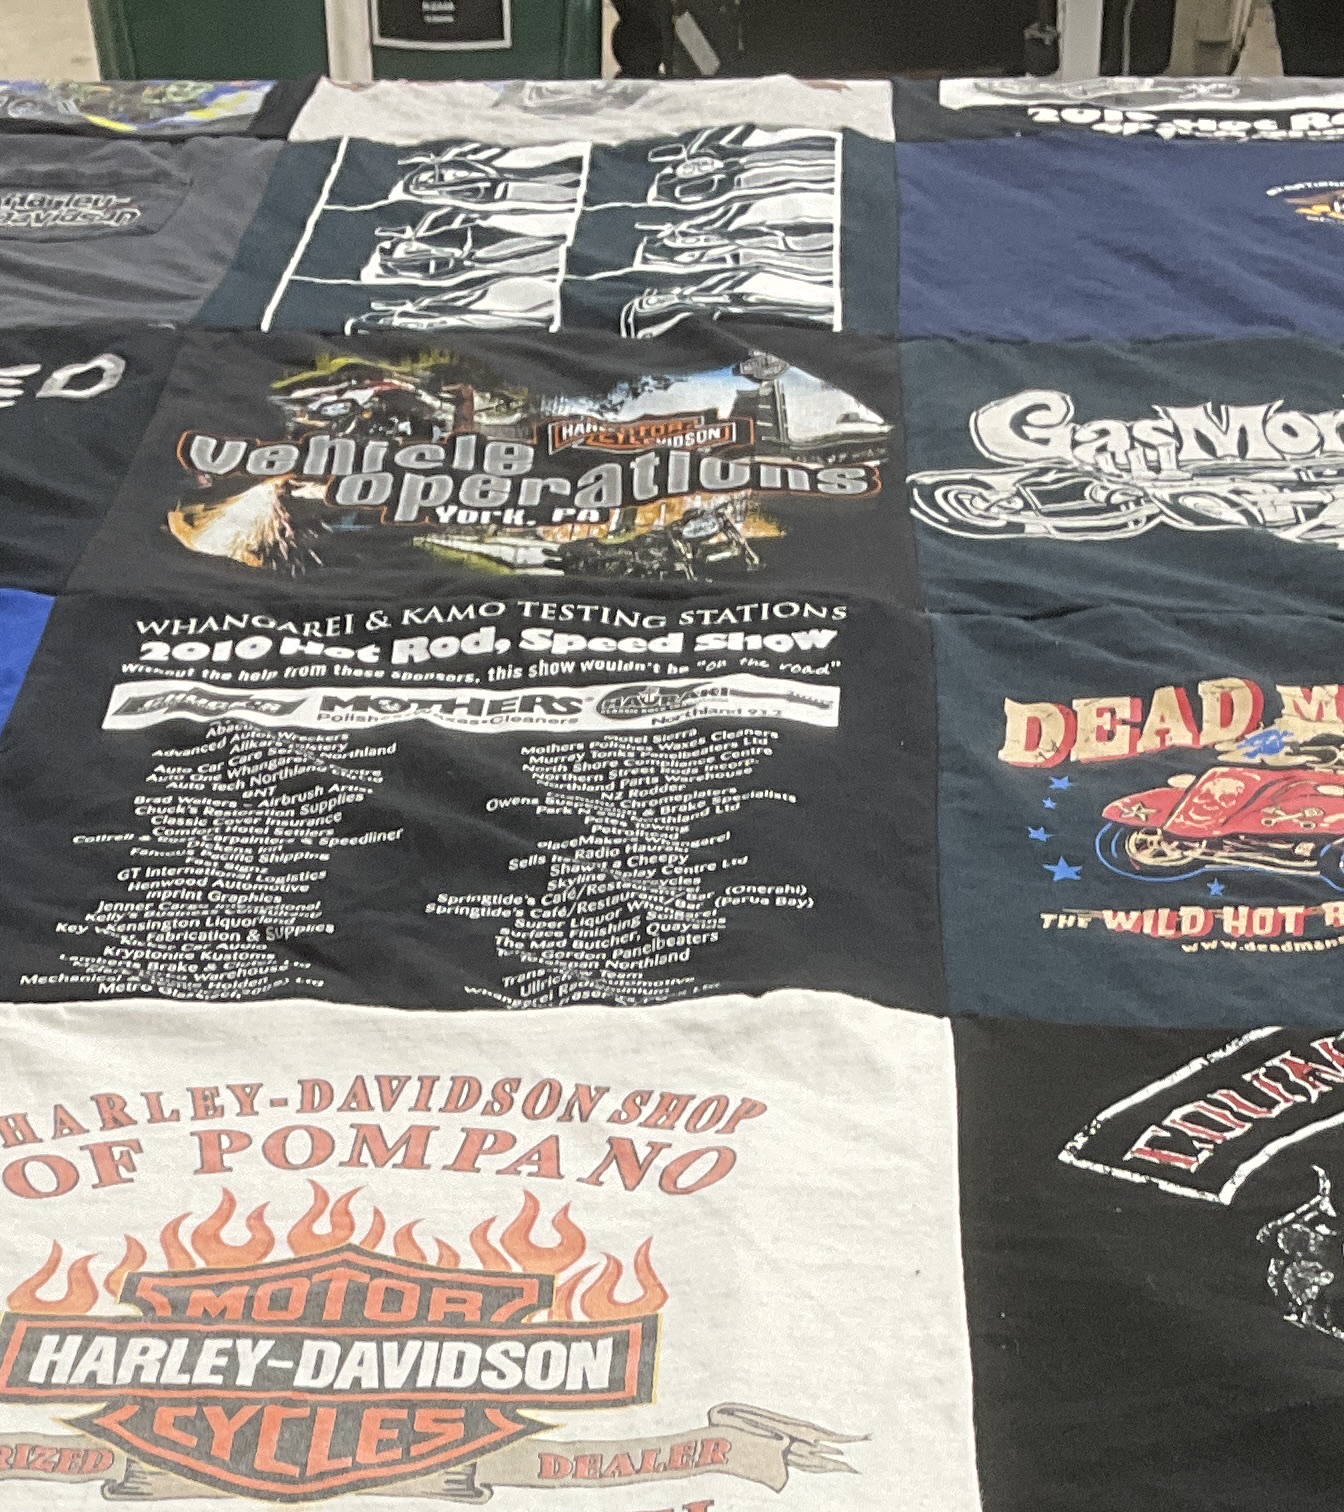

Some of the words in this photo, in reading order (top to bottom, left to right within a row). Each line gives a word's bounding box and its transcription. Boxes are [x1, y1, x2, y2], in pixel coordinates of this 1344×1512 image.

[136, 613, 355, 637] WHANGAREI
[365, 609, 392, 631] &
[400, 602, 506, 625] KAMO
[516, 601, 667, 629] TESTING
[679, 602, 847, 626] STATIONS
[139, 635, 273, 662] 2010
[279, 636, 381, 663] Hot
[391, 626, 511, 665] Rod,
[519, 627, 684, 655] Speed
[694, 628, 837, 653] Show
[201, 667, 232, 681] the
[237, 668, 279, 682] help
[283, 664, 327, 678] from
[334, 664, 385, 678] these
[487, 664, 523, 682] this
[527, 659, 575, 678] show
[1001, 676, 1263, 767] DEAD
[152, 736, 227, 757] Advanced
[529, 752, 586, 765] Murray
[572, 760, 618, 773] Shore
[258, 785, 324, 808] Airbrush
[151, 815, 207, 827] Classic
[265, 811, 342, 827] Insurance
[575, 846, 620, 860] Radio
[117, 866, 141, 881] GT
[146, 866, 251, 881] International
[256, 870, 326, 884] Logistics
[128, 877, 208, 892] Henwood
[212, 879, 309, 893] Automotive
[515, 918, 565, 929] Super
[570, 907, 622, 928] Liquor
[1040, 912, 1092, 930] THE
[1102, 905, 1215, 939] WILD
[1222, 904, 1310, 938] HOT
[146, 929, 241, 943] Fabrication
[246, 929, 261, 942] &
[612, 932, 718, 960] Panelbeaters
[19, 973, 123, 985] Mechanical
[609, 1087, 768, 1138] SHOP
[0, 1134, 146, 1201] OF
[214, 1123, 739, 1199] POMPANO
[188, 1263, 484, 1324] MOTOR
[28, 1333, 616, 1392] HARLEY-DAVIDSON
[153, 1403, 484, 1476] CYCLES
[534, 1433, 733, 1483] DEALER
